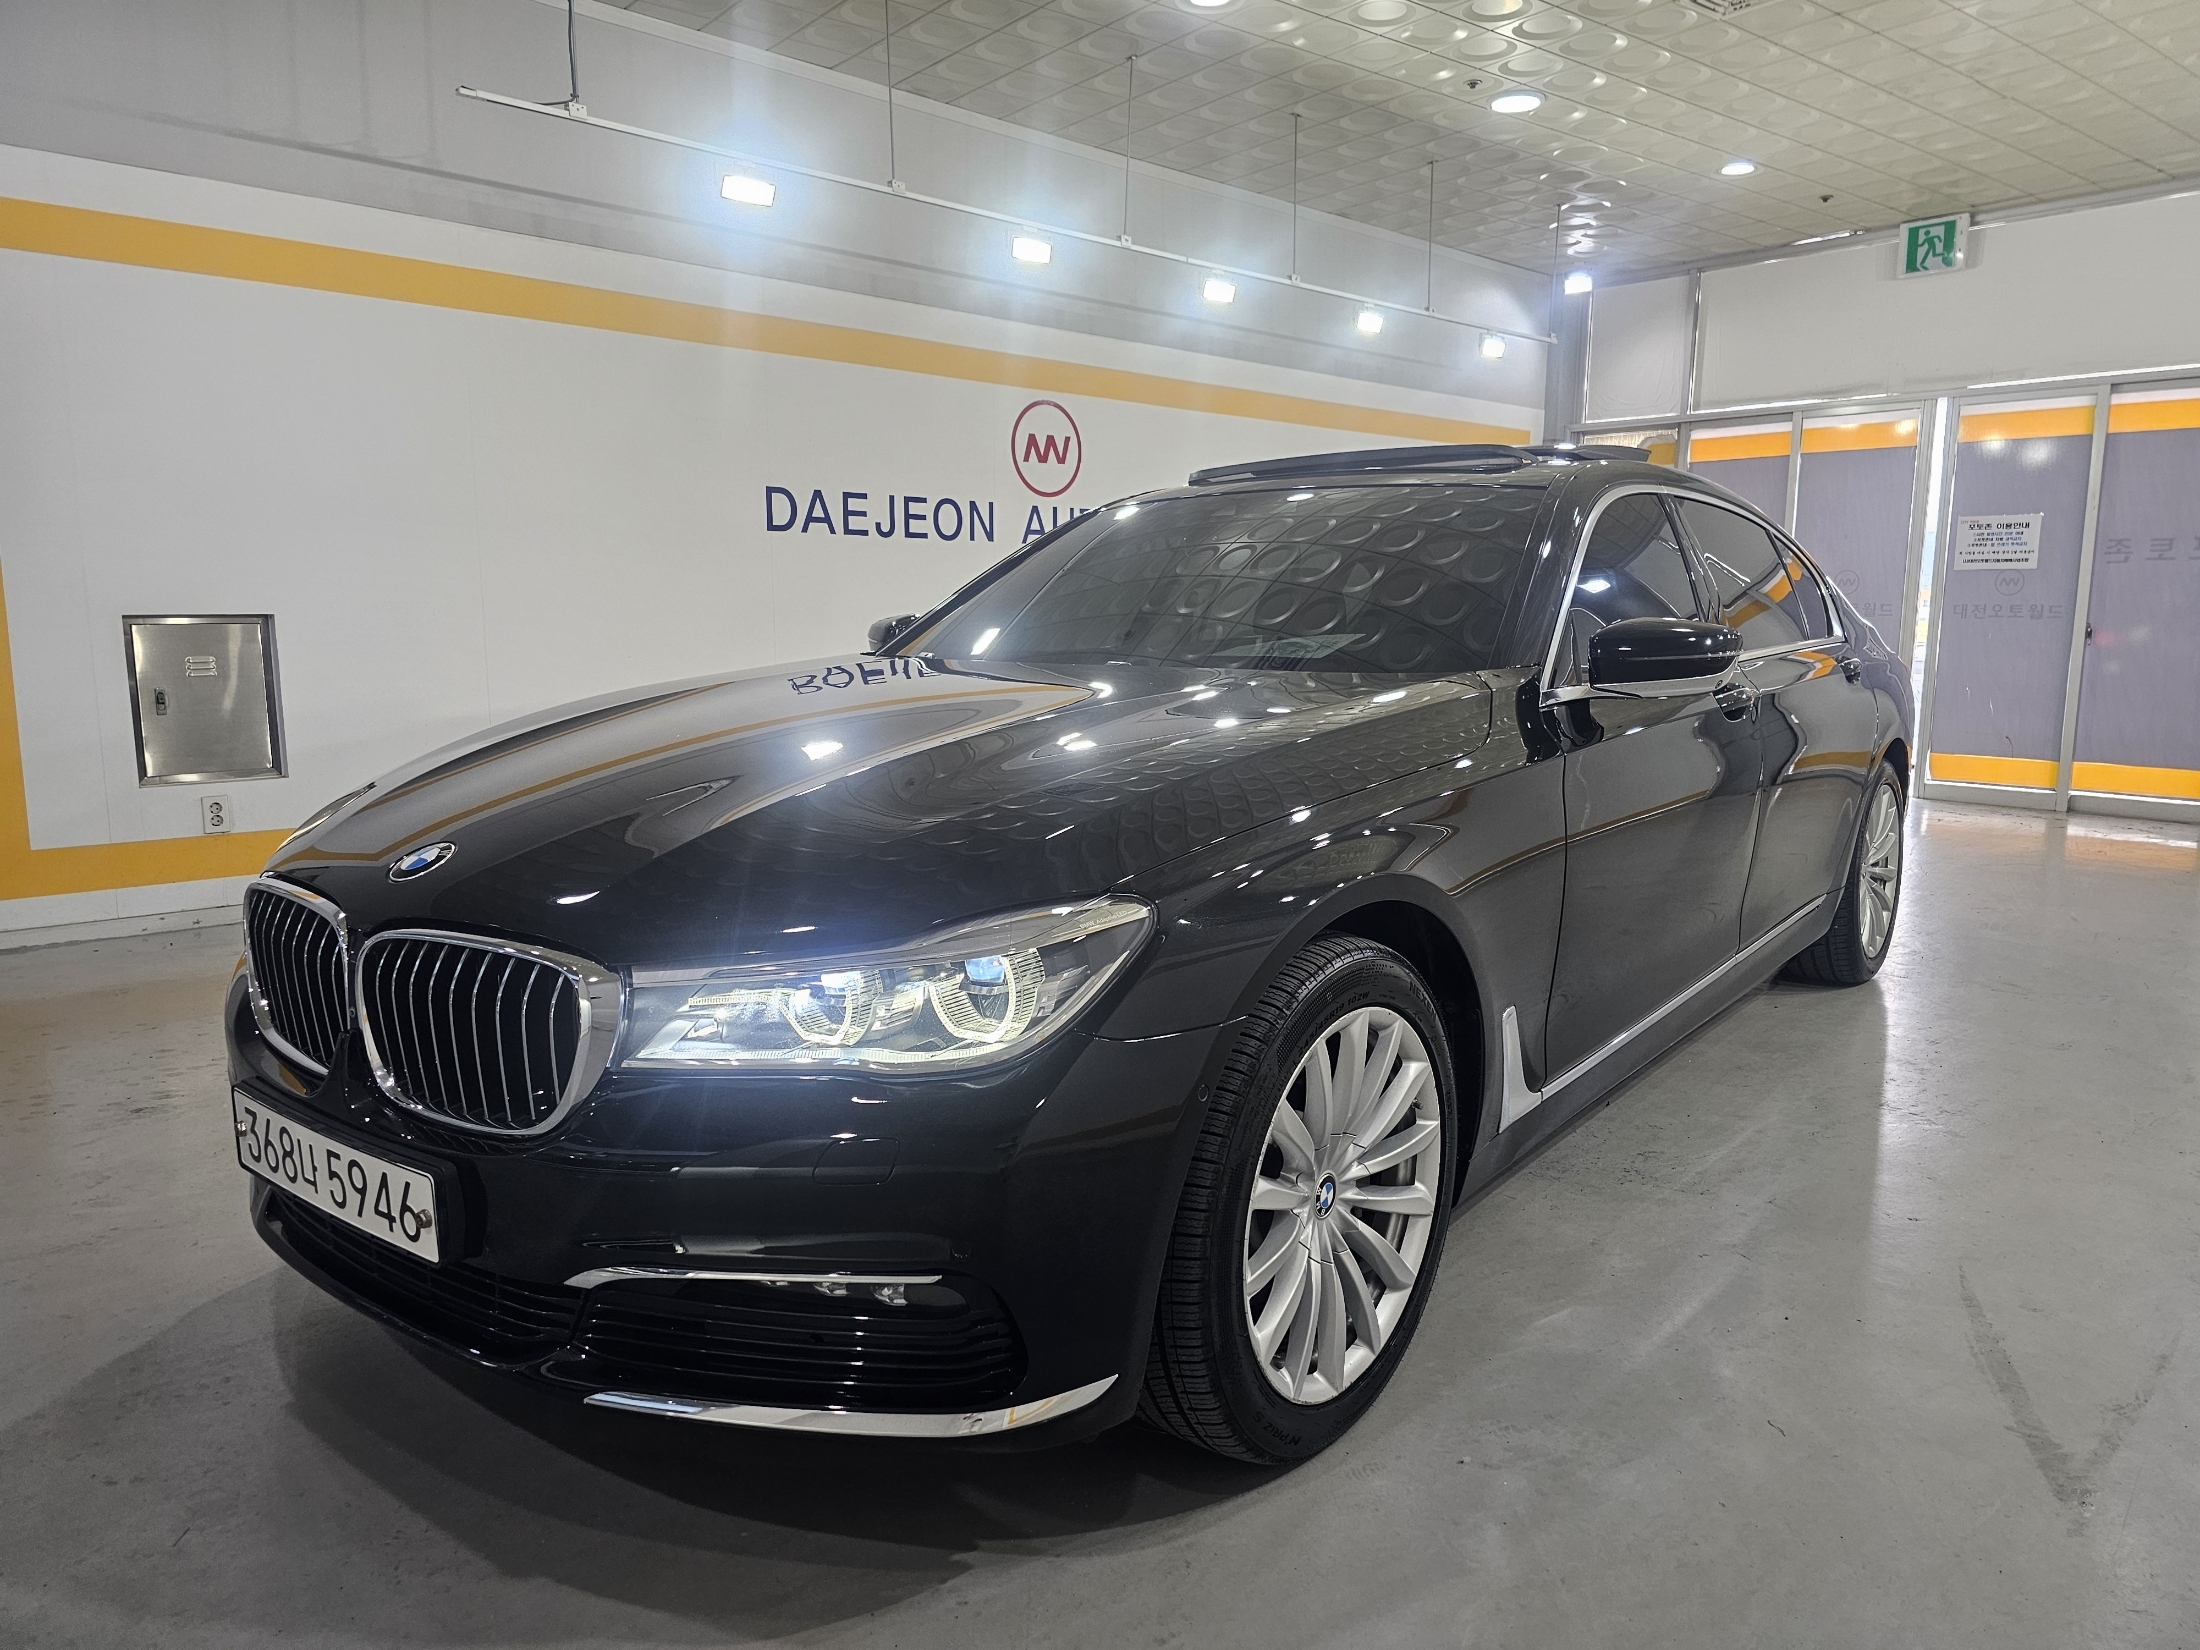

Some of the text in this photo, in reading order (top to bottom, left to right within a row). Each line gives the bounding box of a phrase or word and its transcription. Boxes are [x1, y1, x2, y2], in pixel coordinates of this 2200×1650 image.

[765, 485, 994, 542] DAEJEON
[1996, 522, 2030, 530] 이용안내
[1953, 603, 2064, 620] 대전오토월드
[1347, 991, 1370, 1006] 102W
[1409, 980, 1437, 1023] NEXEN
[244, 1106, 421, 1243] 368나 5946
